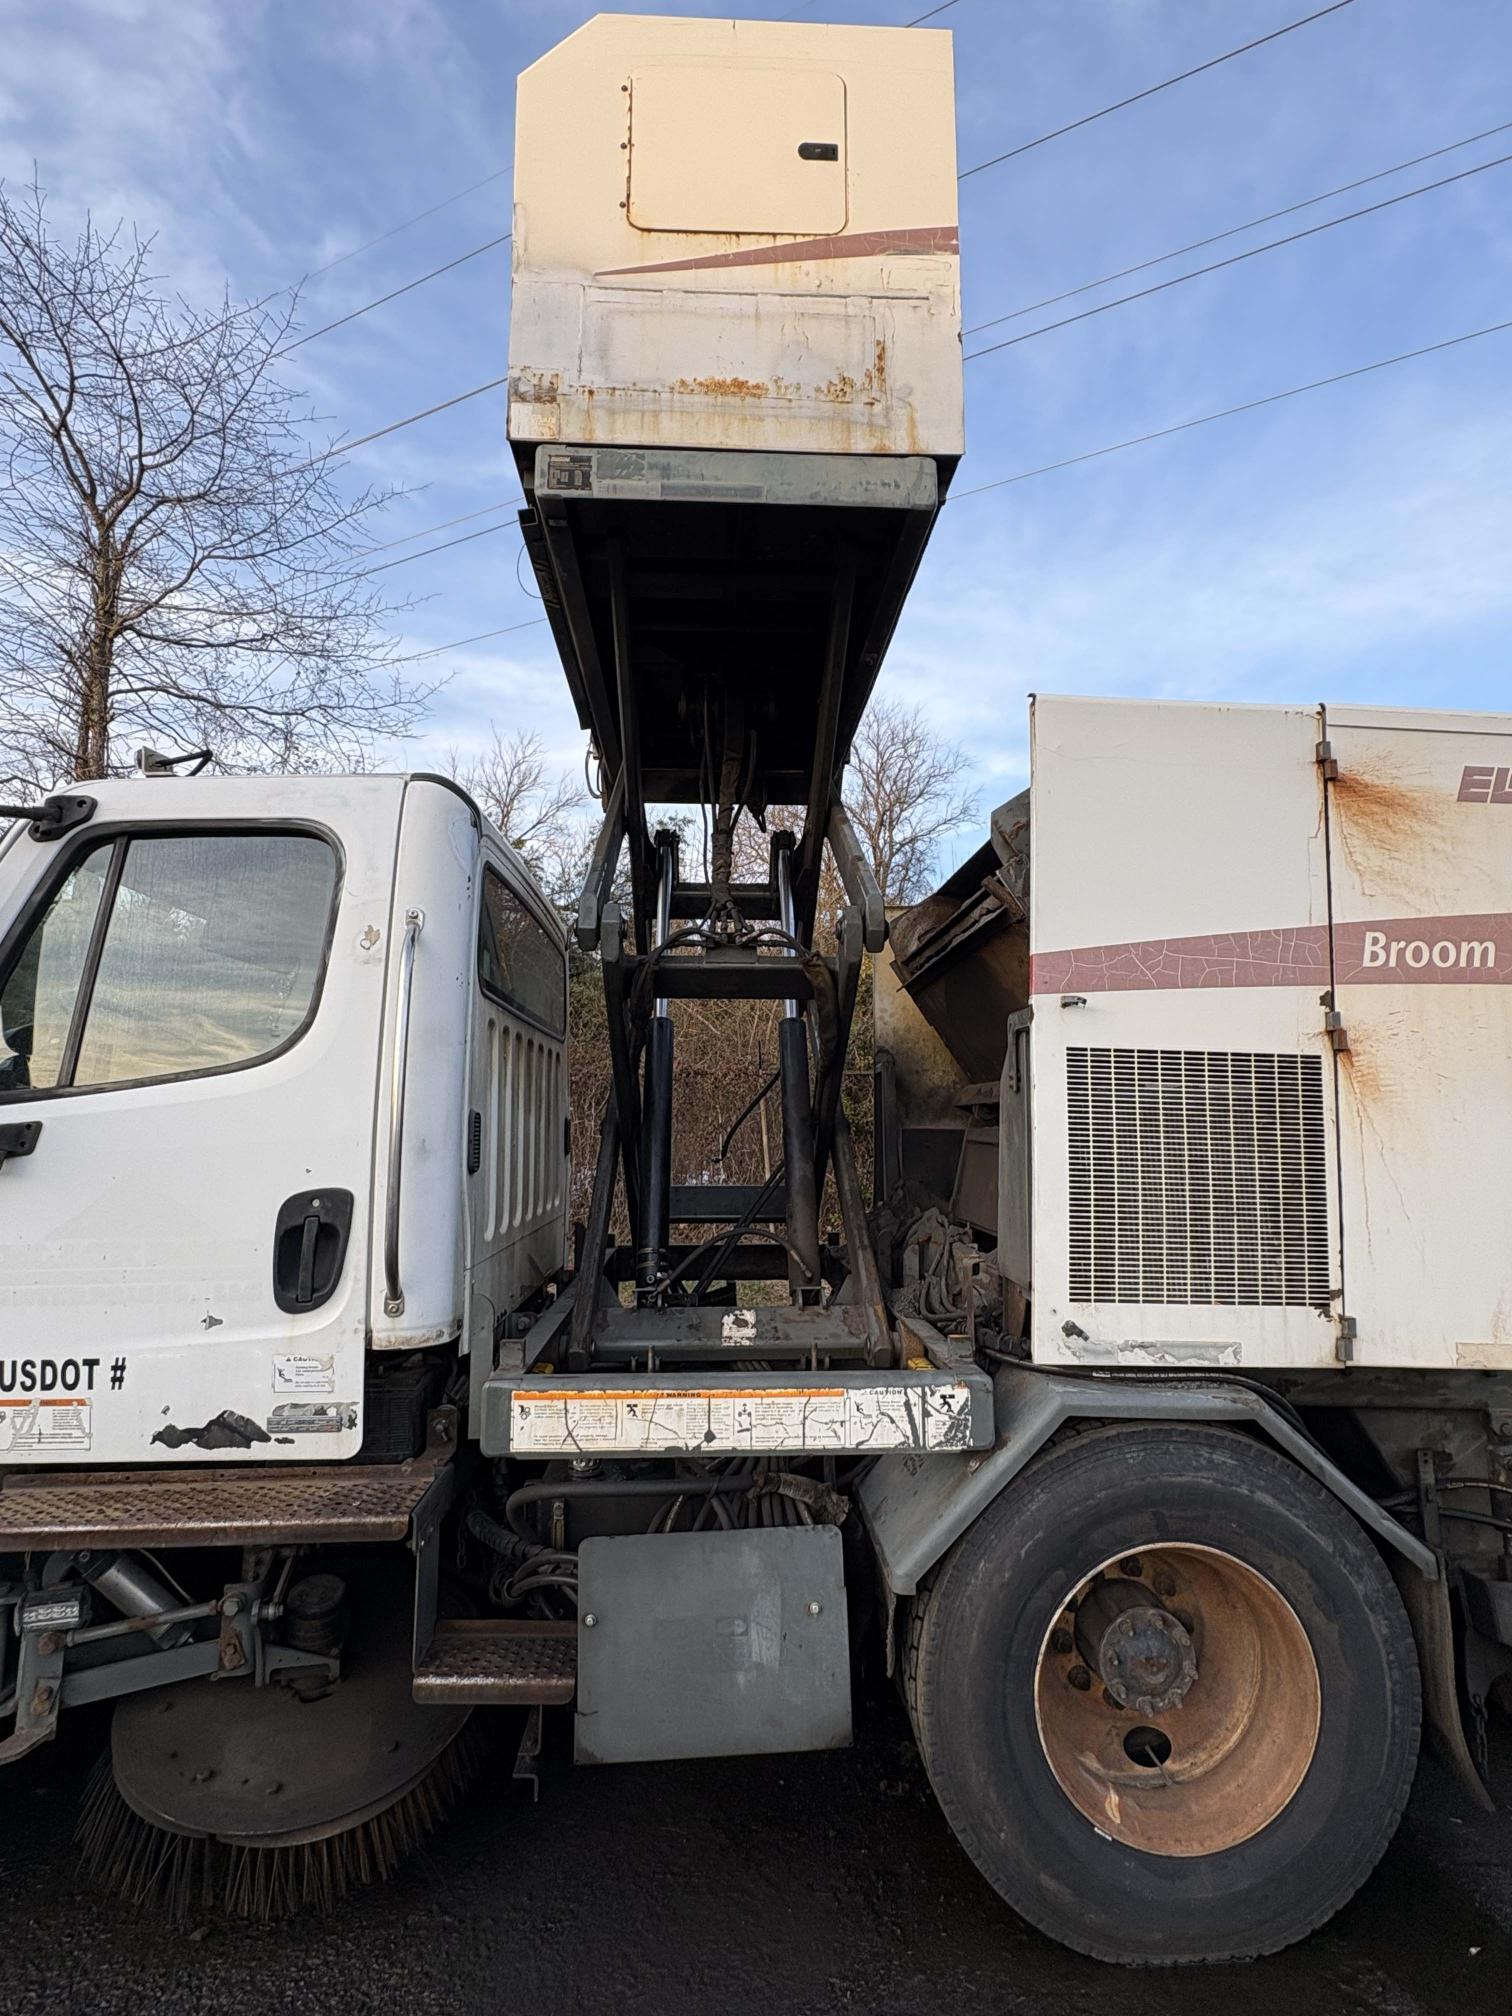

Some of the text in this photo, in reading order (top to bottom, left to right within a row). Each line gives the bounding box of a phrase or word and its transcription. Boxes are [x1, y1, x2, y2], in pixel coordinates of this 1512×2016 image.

[1362, 931, 1497, 969] Broom
[0, 1356, 127, 1392] USDOT #
